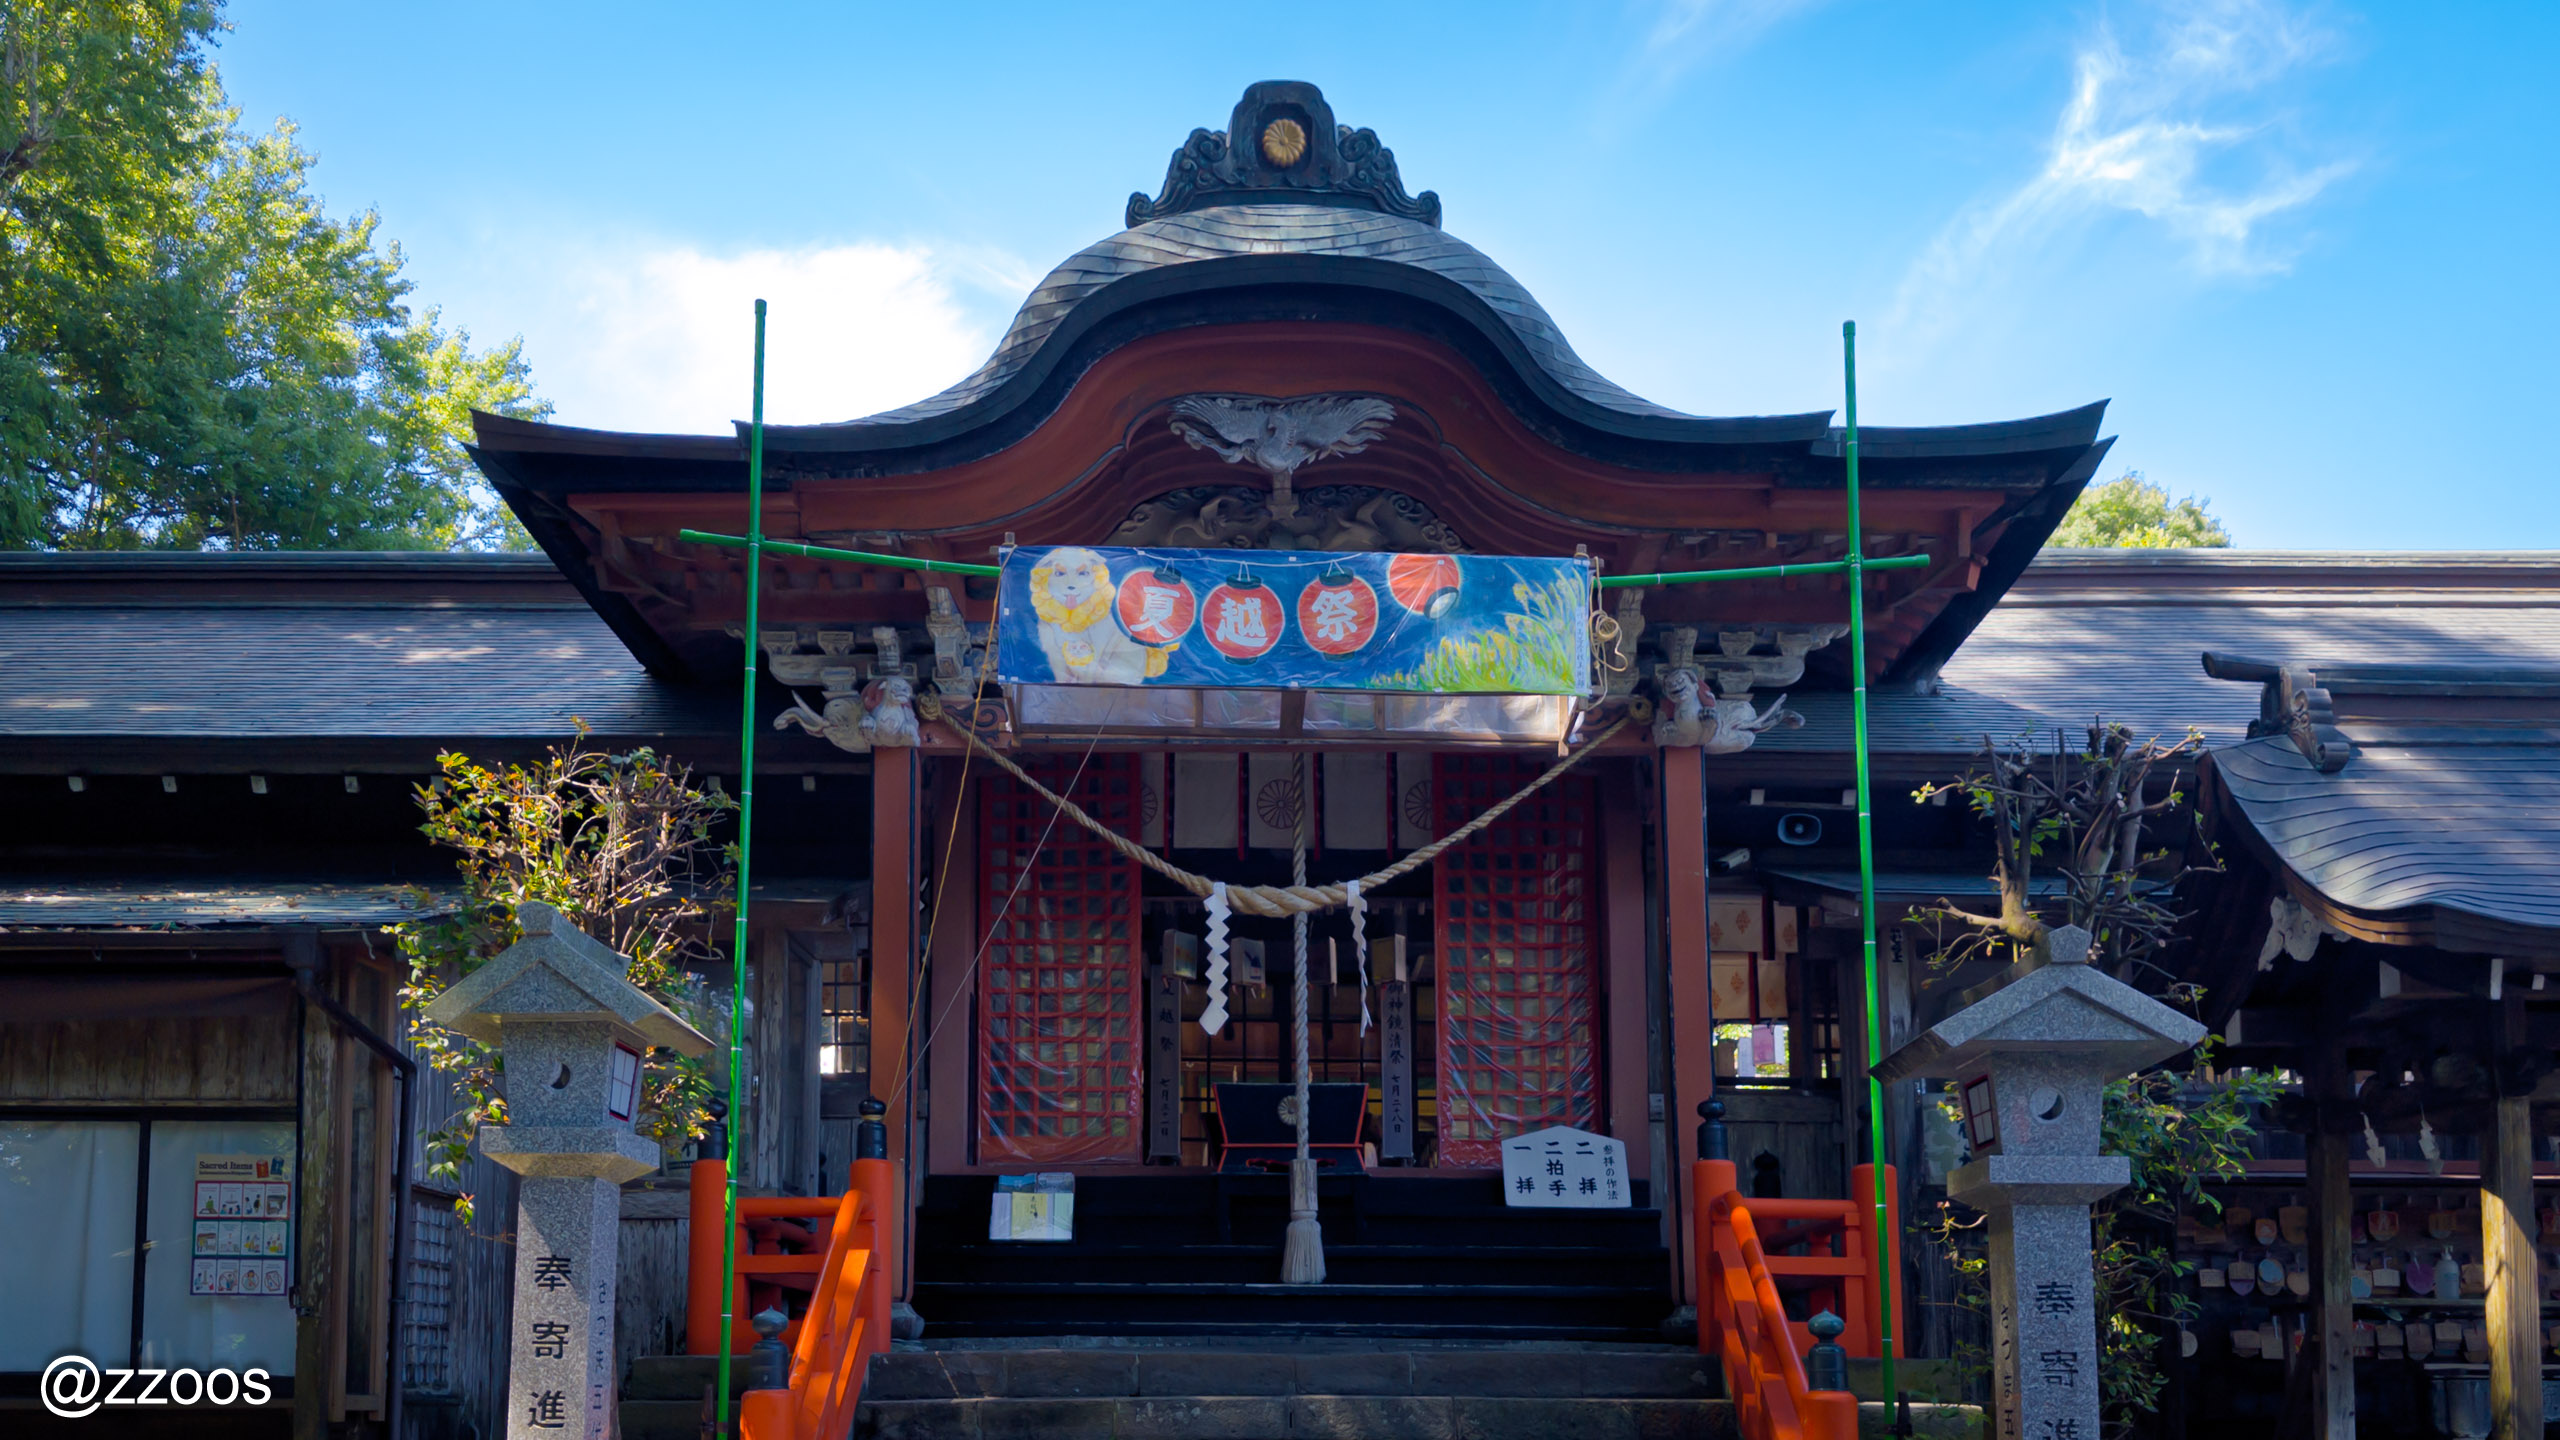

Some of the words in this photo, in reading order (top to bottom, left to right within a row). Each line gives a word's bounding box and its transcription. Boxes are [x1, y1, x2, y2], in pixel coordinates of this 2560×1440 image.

[1130, 586, 1358, 647] 夏越祭
[1391, 1074, 1405, 1133] 七月二十八日
[199, 1161, 228, 1169] Sacred
[1545, 1141, 1567, 1197] 二拍手
[528, 1254, 571, 1429] 奉寄進
